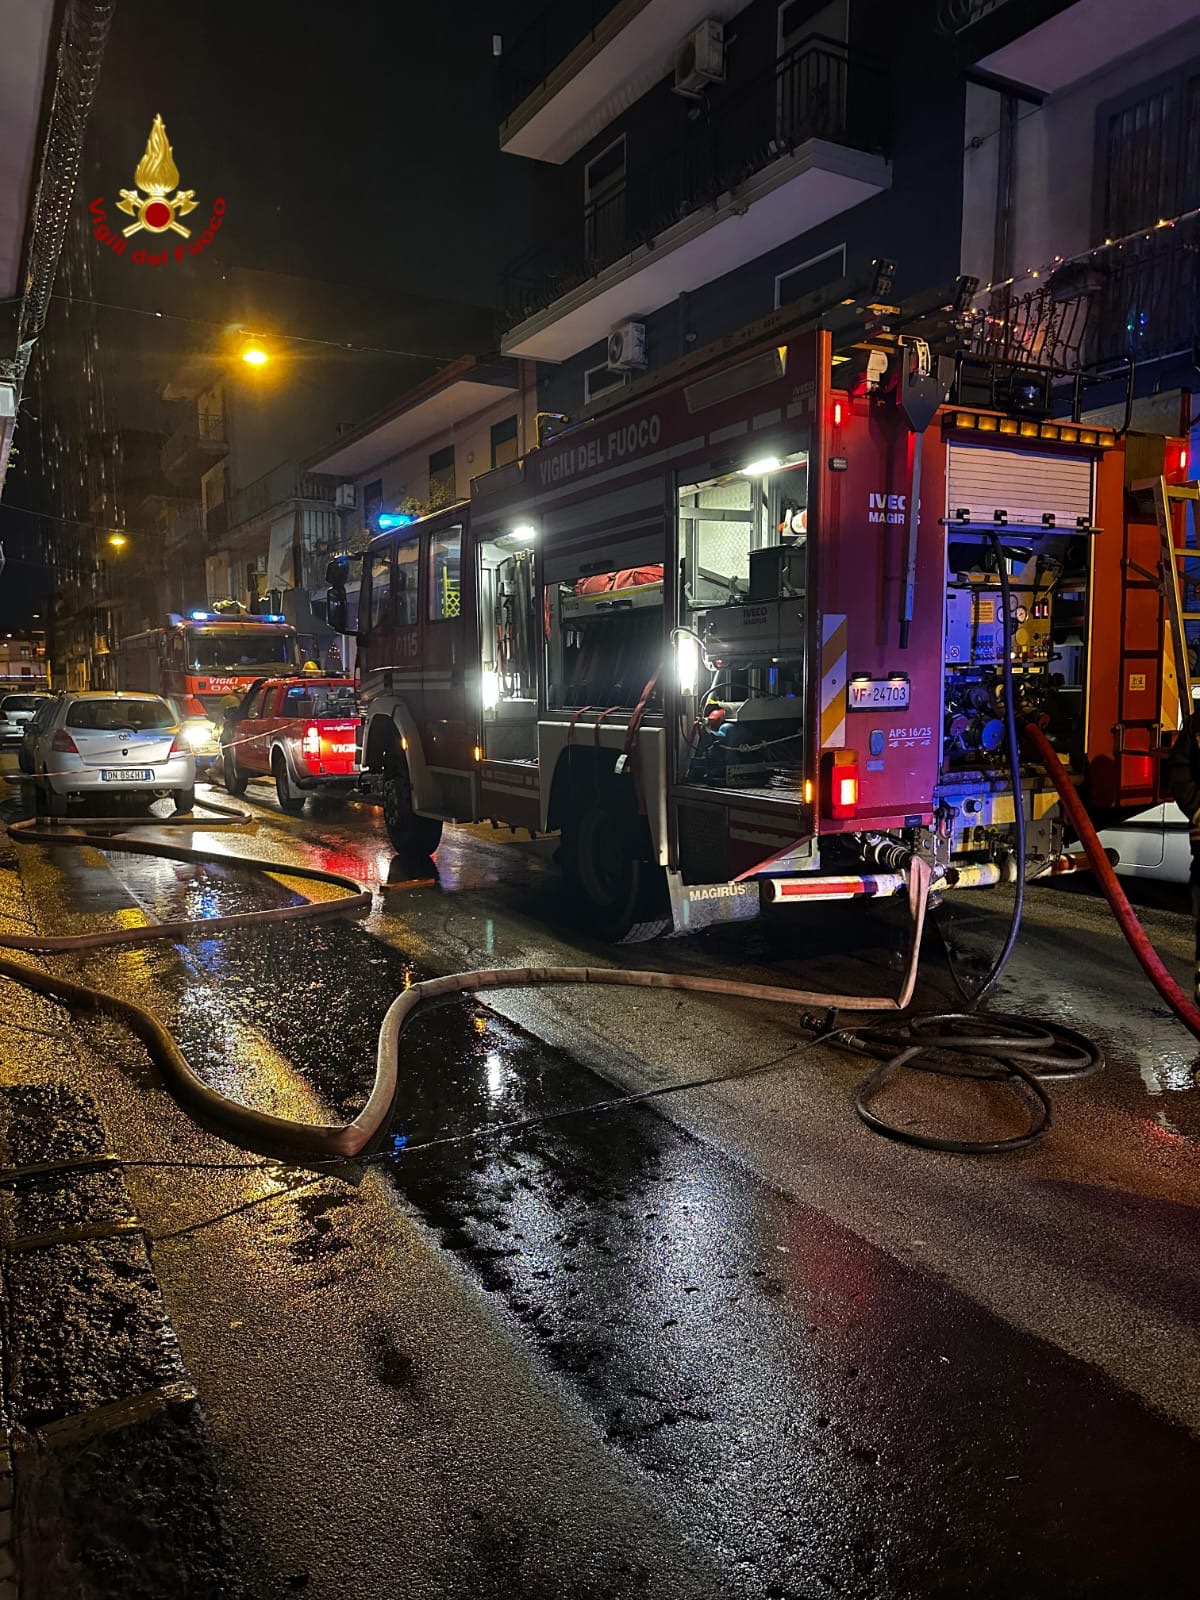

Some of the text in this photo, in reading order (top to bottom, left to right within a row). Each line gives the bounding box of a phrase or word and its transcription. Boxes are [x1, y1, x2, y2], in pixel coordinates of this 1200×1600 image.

[540, 414, 660, 485] VIGILI DEL FUOCO
[869, 493, 921, 510] IVEC
[868, 511, 921, 525] MAGIR
[743, 606, 768, 618] IVECO
[209, 677, 238, 685] VIGILI
[889, 727, 931, 738] APS 16/25
[689, 884, 746, 902] MAGIRUS
